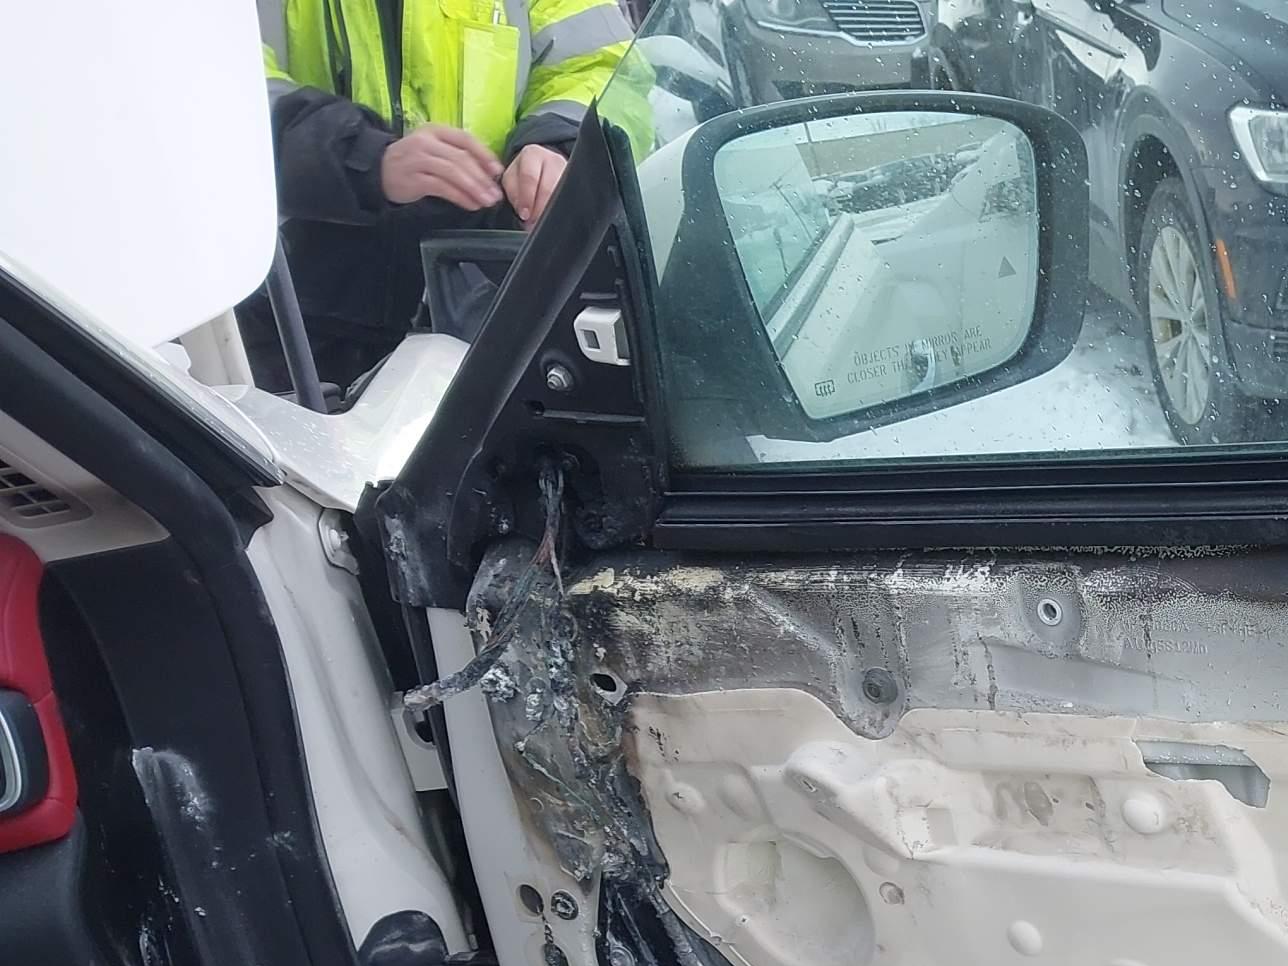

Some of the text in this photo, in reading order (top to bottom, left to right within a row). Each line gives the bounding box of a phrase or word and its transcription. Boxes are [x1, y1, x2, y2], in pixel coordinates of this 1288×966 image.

[854, 345, 900, 366] OBJECTS
[964, 326, 983, 340] ARE
[847, 364, 888, 384] CLOSER
